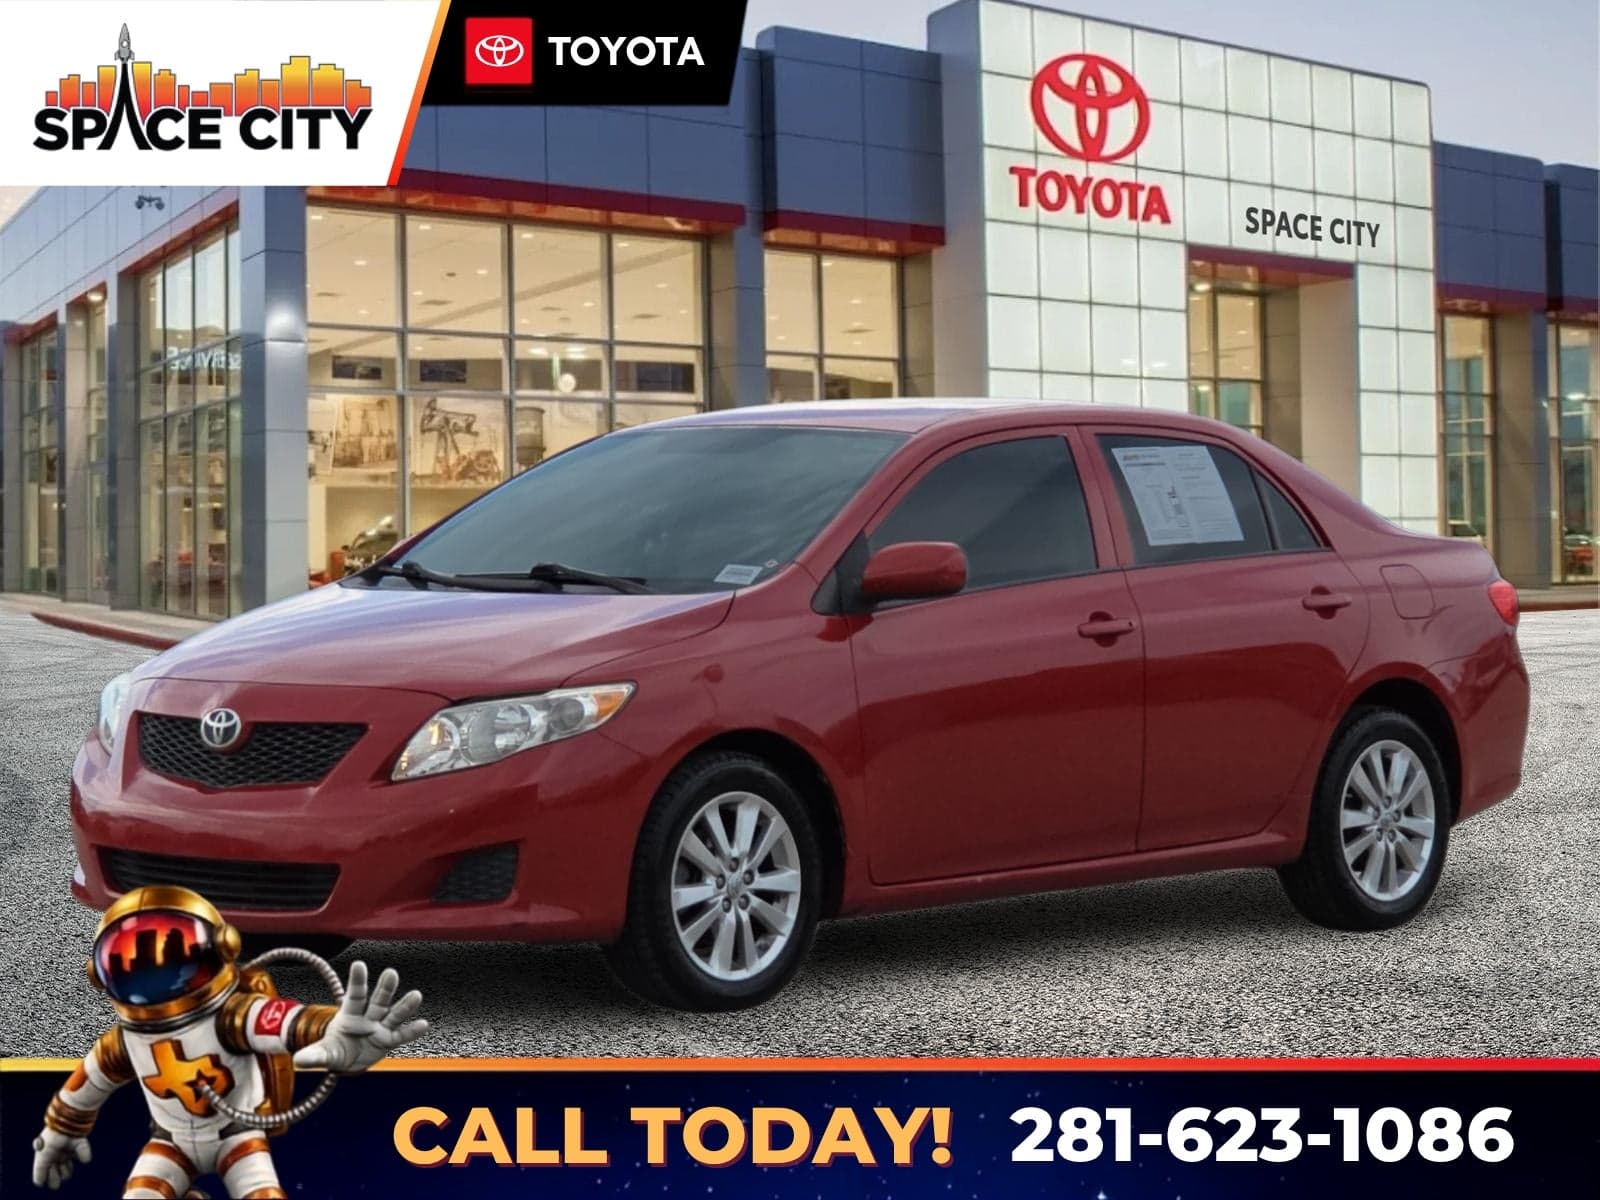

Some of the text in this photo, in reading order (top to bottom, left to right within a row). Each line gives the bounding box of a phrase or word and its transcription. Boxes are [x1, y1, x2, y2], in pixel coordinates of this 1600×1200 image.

[1009, 166, 1171, 224] TOYOTA
[1245, 207, 1380, 248] SPACE CITY
